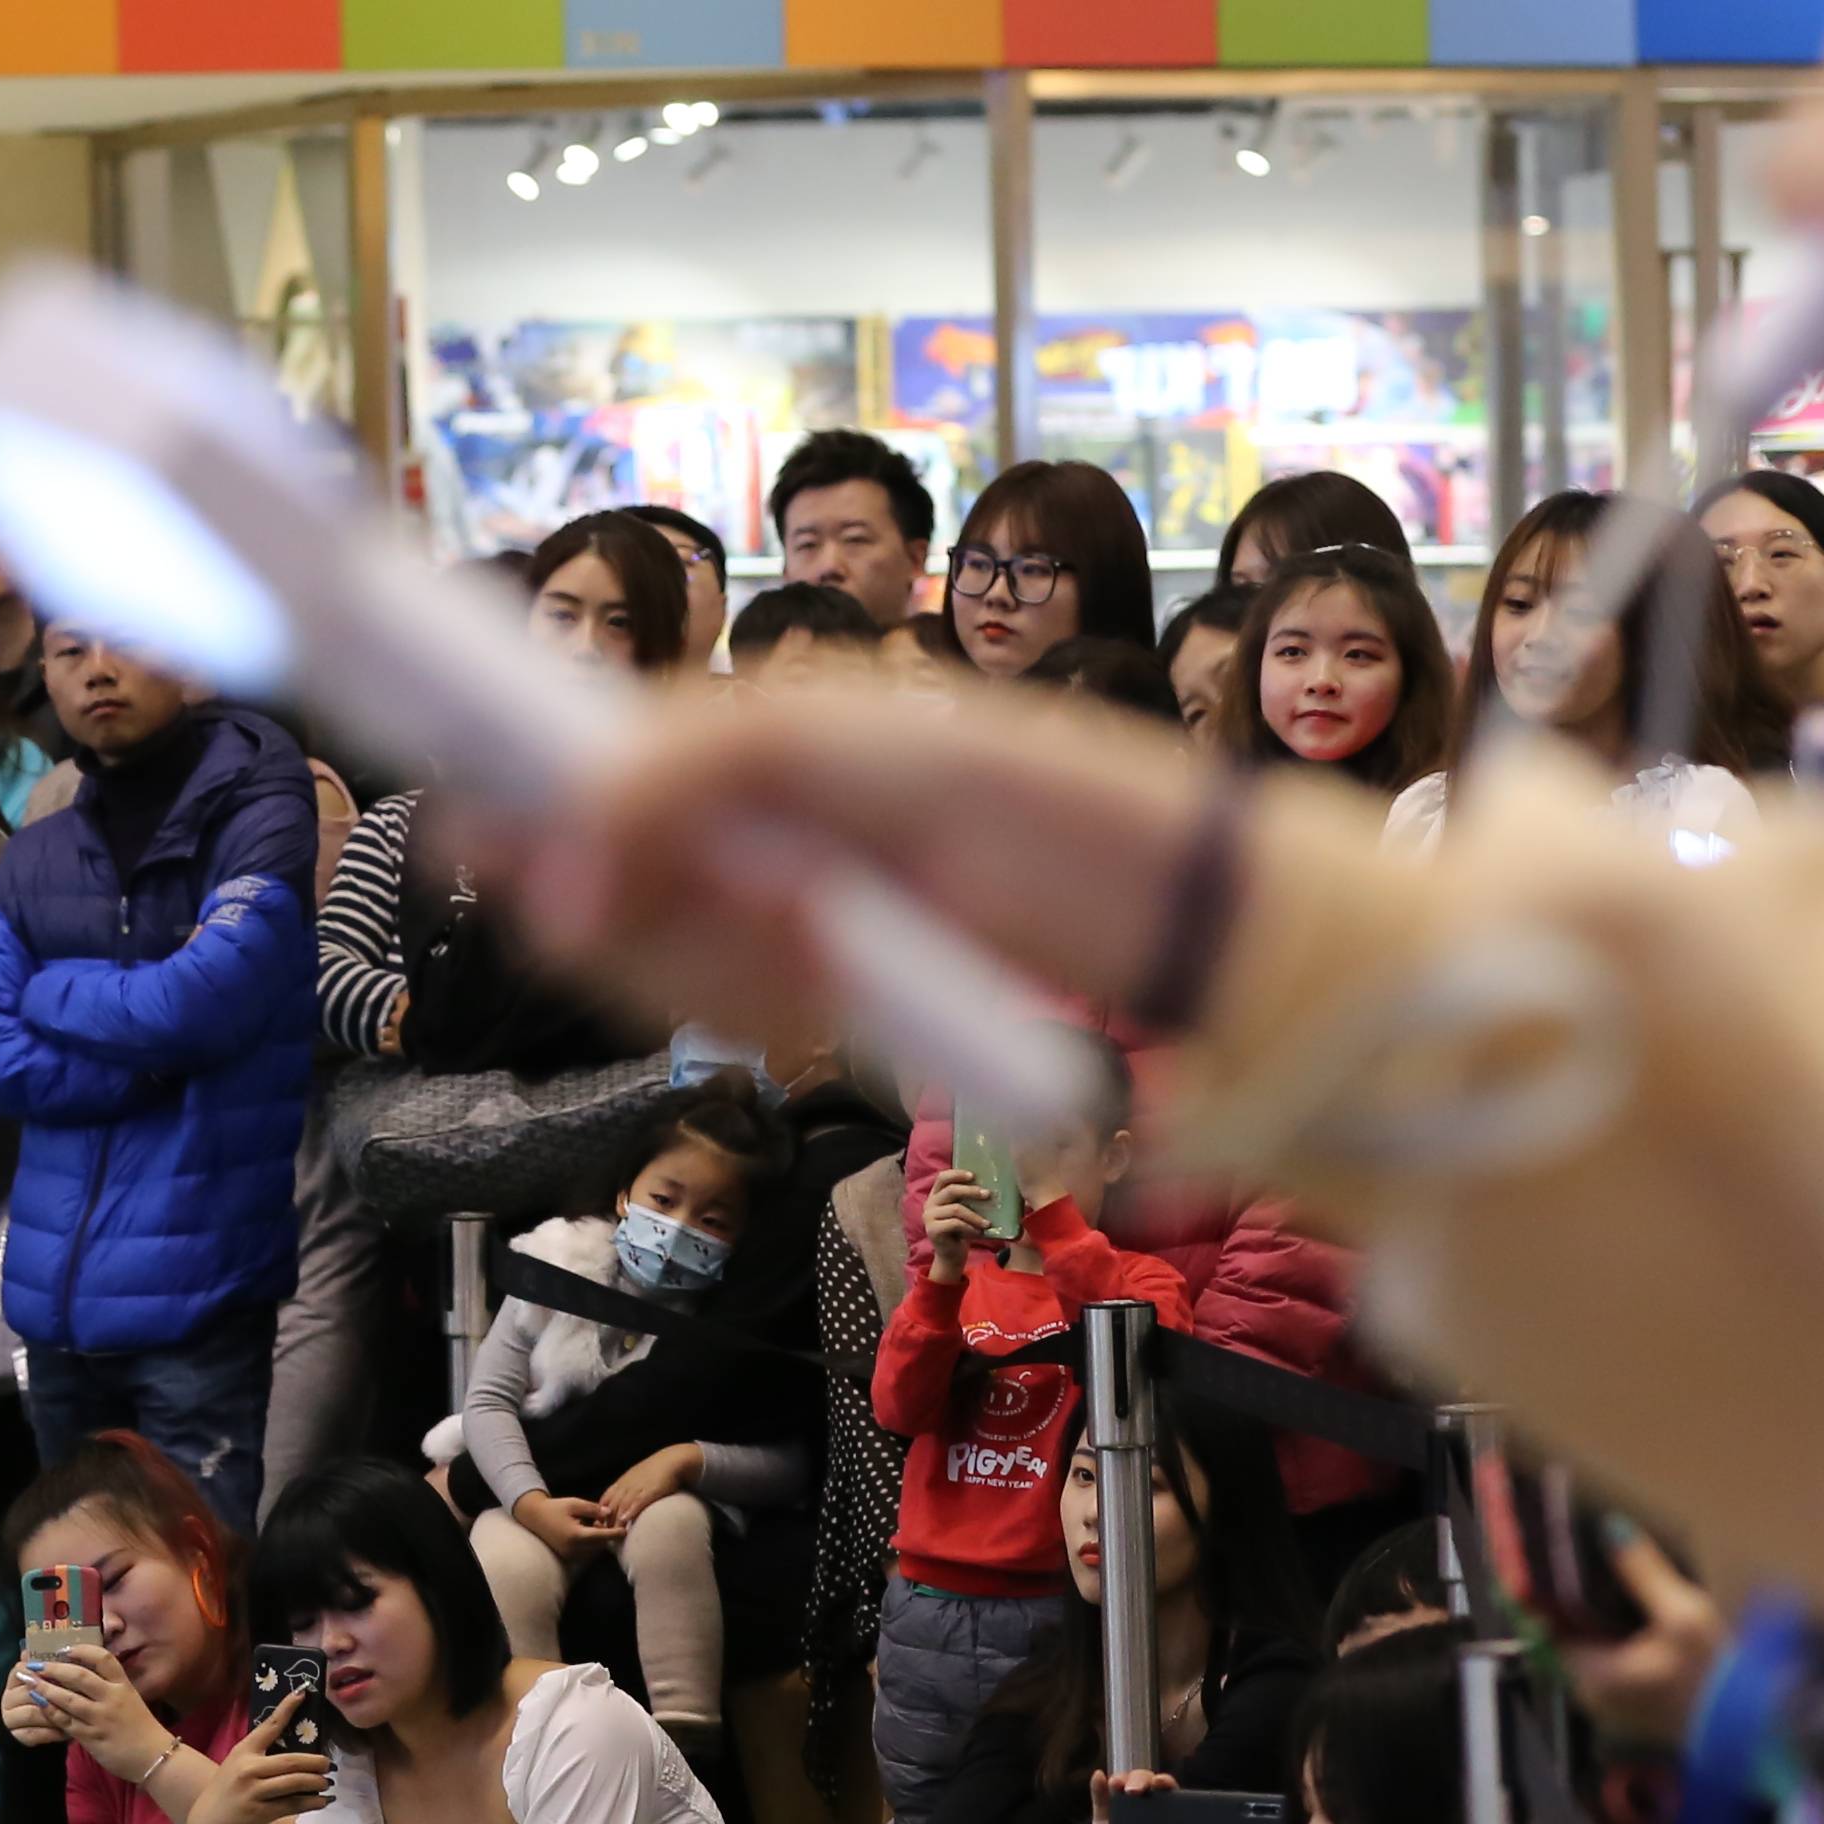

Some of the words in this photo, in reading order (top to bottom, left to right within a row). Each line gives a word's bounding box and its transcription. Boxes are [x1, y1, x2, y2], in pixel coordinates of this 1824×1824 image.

[964, 1475, 986, 1486] HAPPY
[987, 1478, 1006, 1488] NEW
[1008, 1479, 1034, 1489] YEAR!
